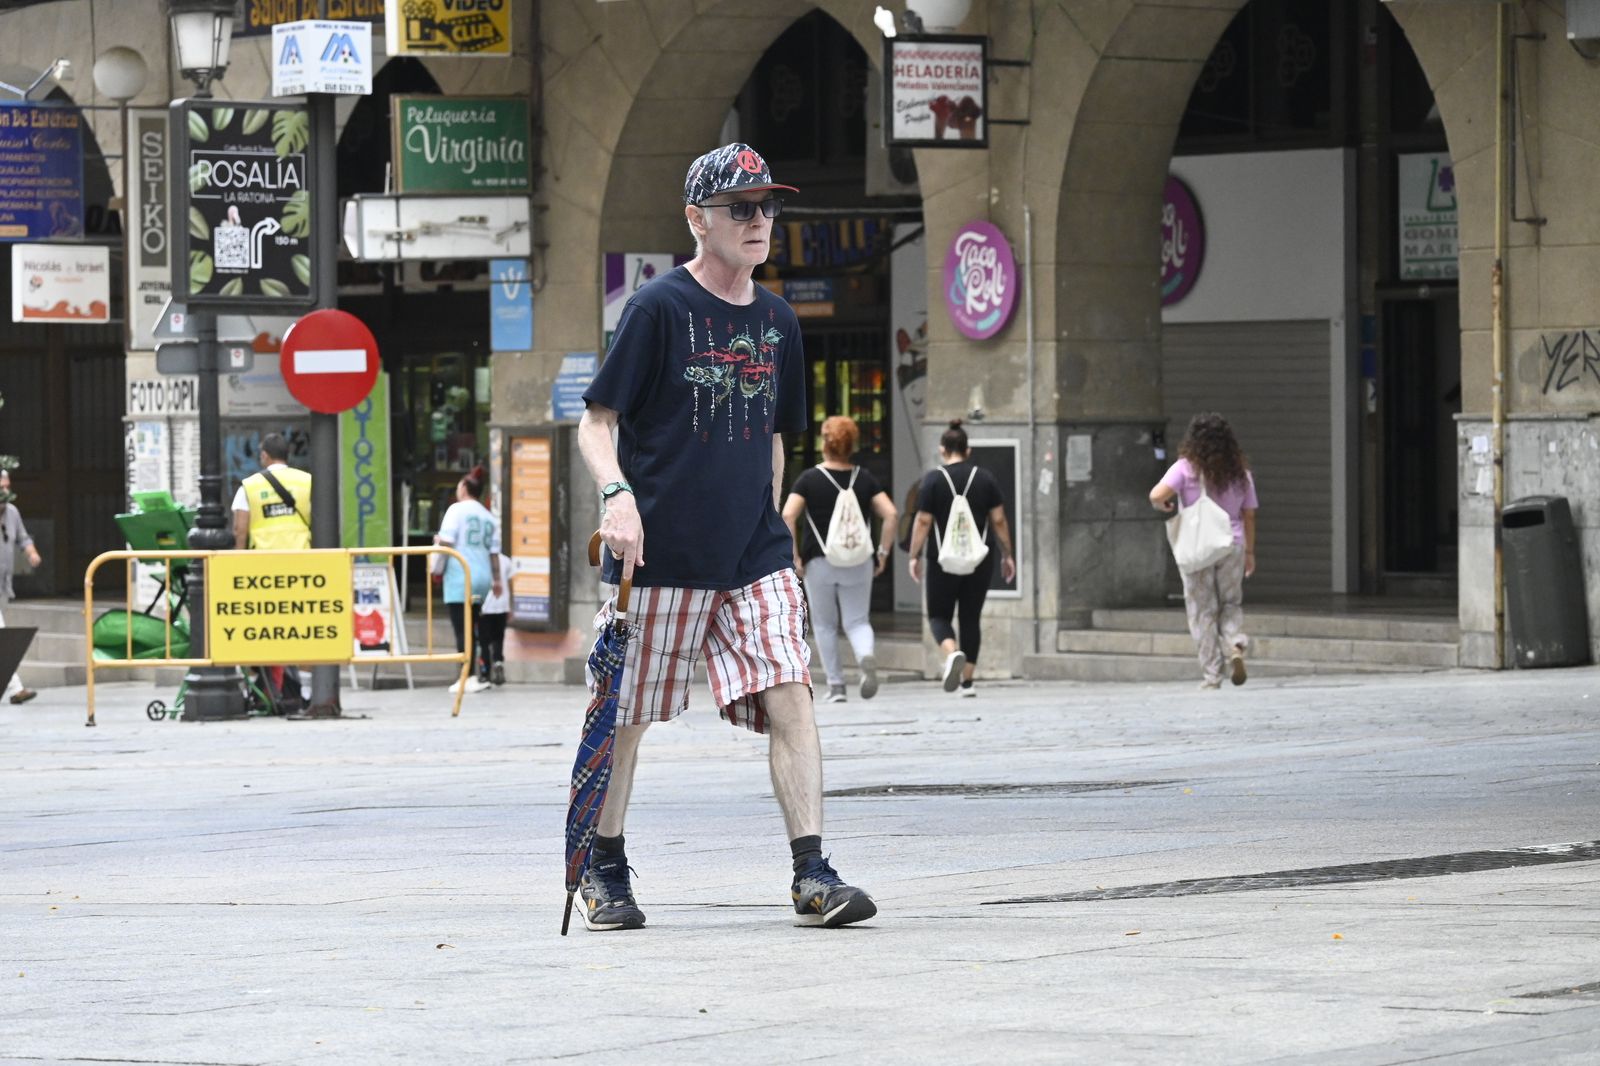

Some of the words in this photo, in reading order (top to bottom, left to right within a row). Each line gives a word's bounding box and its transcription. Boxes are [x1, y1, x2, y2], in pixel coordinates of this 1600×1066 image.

[442, 0, 502, 11] VIDEO
[452, 24, 494, 41] CLUB
[895, 63, 980, 79] HELADERÍA
[12, 108, 28, 127] De
[405, 124, 524, 174] Virginia
[197, 157, 300, 189] ROSALÍA
[141, 131, 165, 253] SEIKO
[224, 192, 236, 202] LA
[1404, 227, 1458, 240] GOM
[955, 230, 997, 269] Taco
[1404, 243, 1452, 256] MAR
[965, 254, 1006, 314] Roll
[233, 575, 327, 590] EXCEPTO
[216, 600, 345, 616] RESIDENTES
[224, 627, 235, 641] Y
[243, 626, 338, 641] GARAJES
